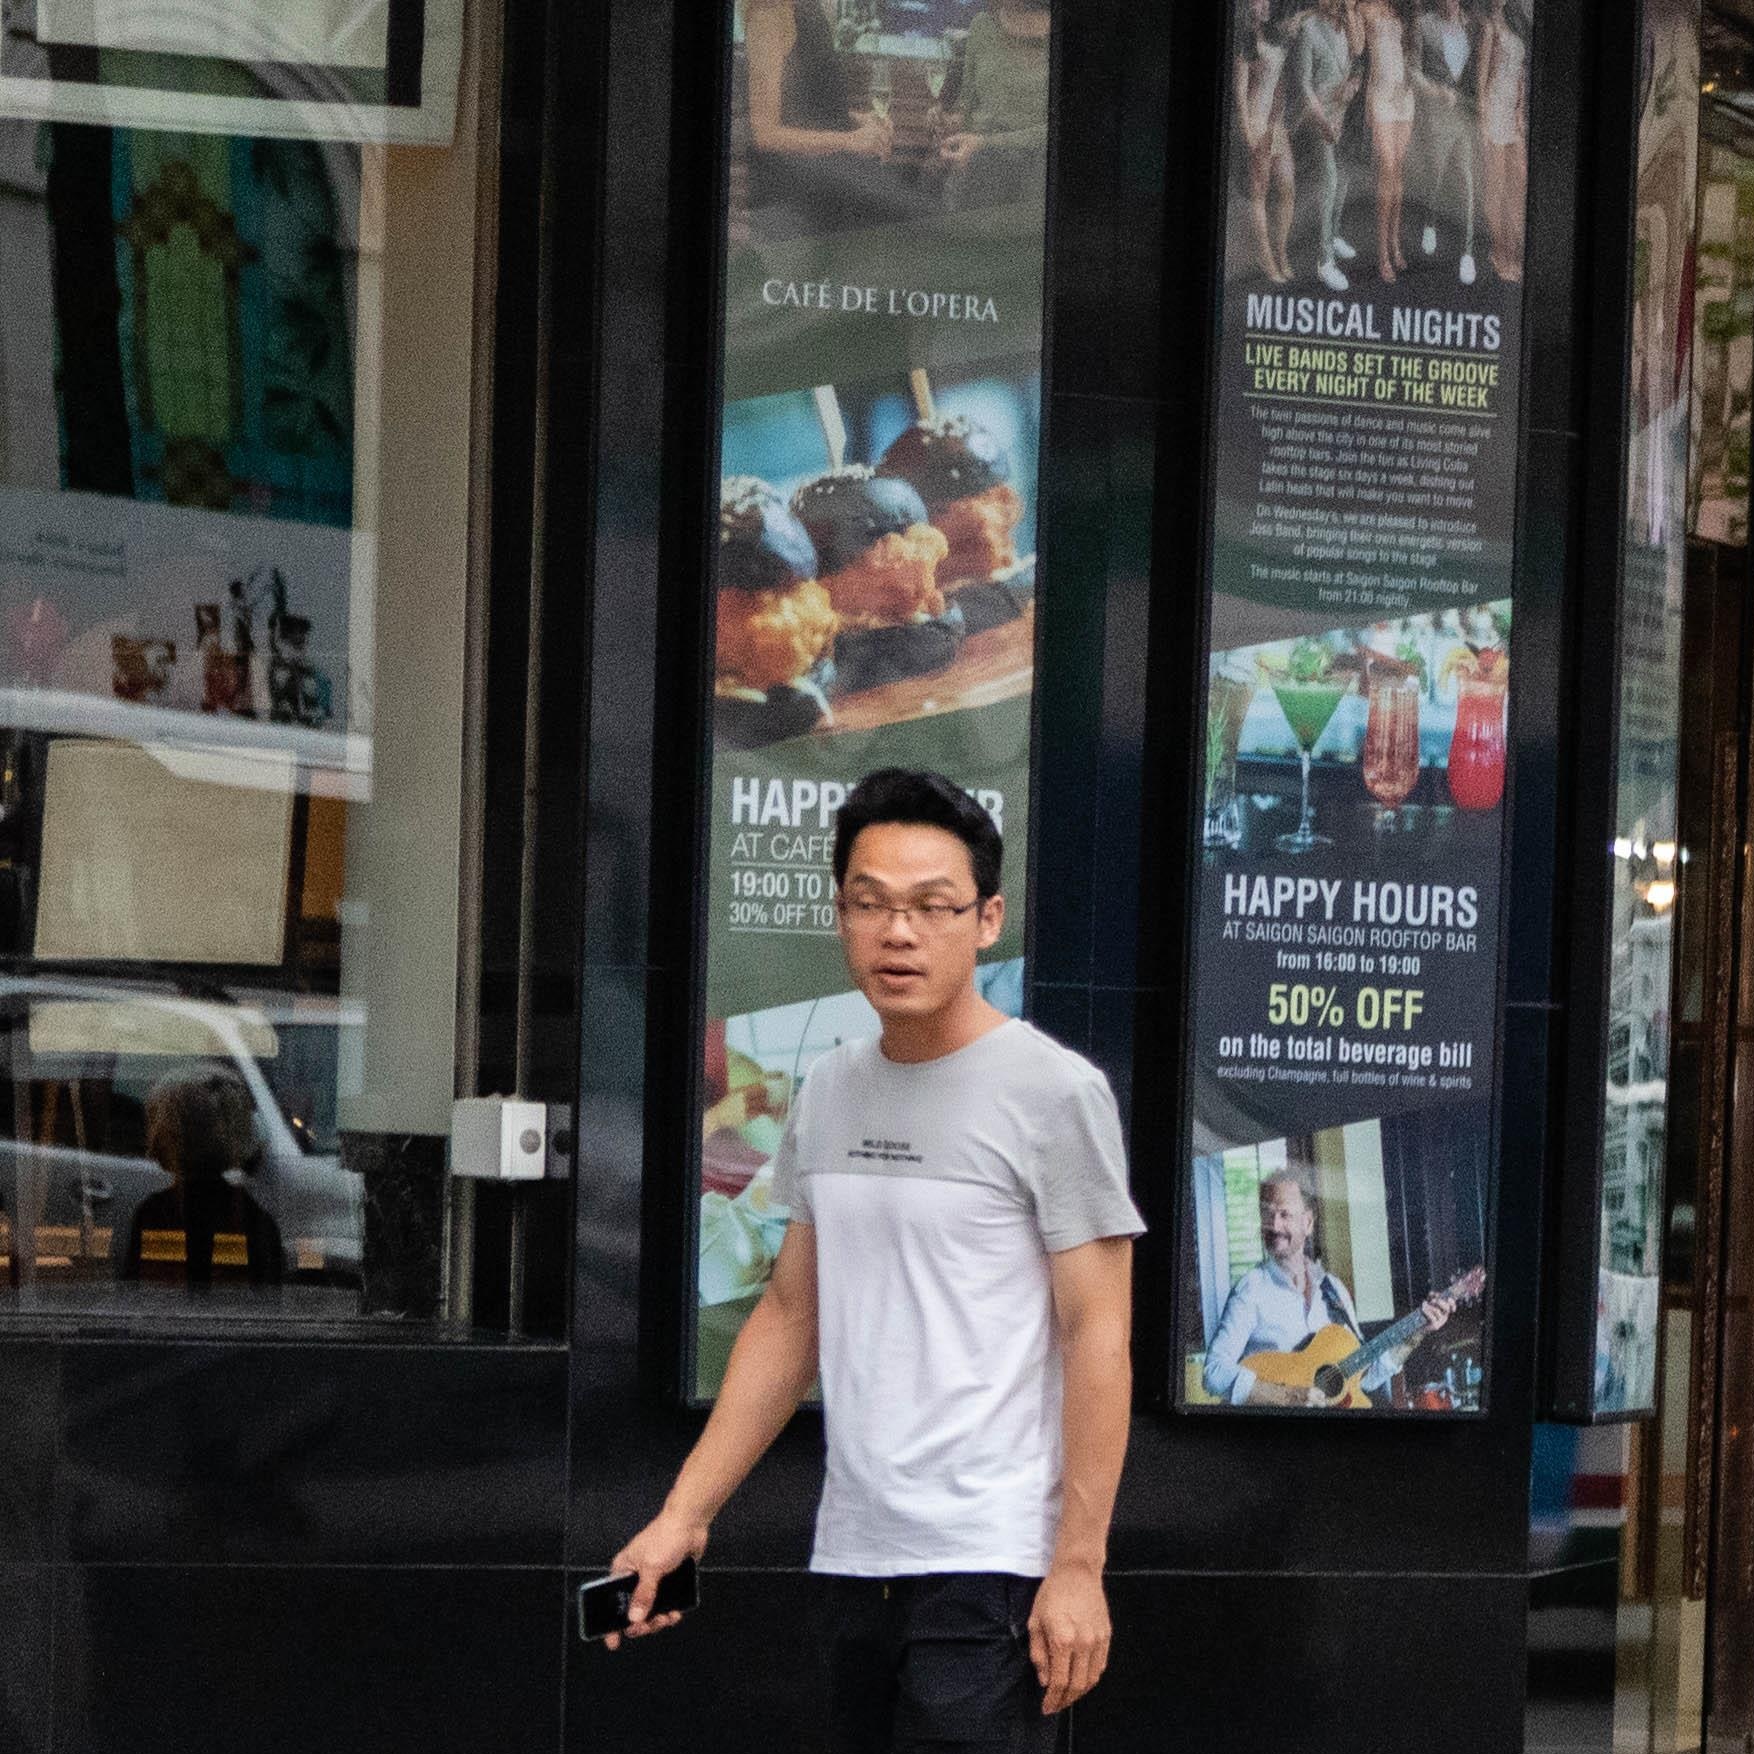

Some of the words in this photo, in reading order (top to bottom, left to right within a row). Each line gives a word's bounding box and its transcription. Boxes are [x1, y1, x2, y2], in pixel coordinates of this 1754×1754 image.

[762, 276, 832, 309] CAFÉ
[842, 285, 878, 313] DE
[887, 288, 999, 323] L'OPERA
[1246, 293, 1382, 340] MUSICAL
[1391, 305, 1501, 351] NIGHTS
[1245, 342, 1284, 366] LIVE
[1288, 346, 1348, 373] BANDS
[1353, 351, 1386, 376] SET
[1390, 355, 1424, 380] THE
[1427, 358, 1500, 387] GROOVE
[1254, 367, 1311, 393] EVERY
[1315, 372, 1370, 398] NIGHT
[1374, 377, 1398, 400] OF
[1402, 380, 1435, 404] THE
[1440, 384, 1489, 408] WEEK
[1354, 414, 1383, 430] dance
[1386, 417, 1404, 430] and
[1261, 425, 1284, 441] high
[1285, 427, 1316, 442] above
[1318, 429, 1333, 443] the
[1336, 431, 1353, 447] city
[1369, 435, 1386, 447] one
[1389, 434, 1399, 448] of
[1417, 438, 1442, 452] most
[1360, 450, 1375, 465] the
[1378, 451, 1394, 466] fun
[1262, 461, 1288, 476] takes
[1290, 462, 1307, 477] the
[1309, 465, 1336, 481] stage
[1355, 468, 1378, 485] days
[1259, 478, 1285, 494] Latin
[1315, 482, 1335, 497] that
[1358, 486, 1384, 502] make
[1386, 490, 1404, 504] you
[1407, 490, 1431, 505] want
[1433, 492, 1443, 506] to
[1343, 510, 1358, 524] we
[1360, 512, 1375, 525] are
[1378, 512, 1416, 530] pleased
[1418, 515, 1429, 530] to
[1306, 525, 1348, 545] bringing
[1306, 545, 1344, 562] popular
[1380, 548, 1390, 563] to
[1250, 563, 1268, 579] The
[1271, 565, 1301, 581] music
[1346, 571, 1381, 589] Saigon
[1383, 573, 1417, 591] Saigon
[1461, 578, 1478, 594] Bar
[1318, 587, 1342, 602] from
[731, 776, 856, 829] HAPP
[730, 832, 764, 859] AT
[730, 870, 789, 899] 19:00
[796, 872, 822, 900] TO
[729, 901, 768, 925] 30%
[773, 903, 807, 927] OFF
[1224, 873, 1342, 921] HAPPY
[1353, 880, 1479, 929] HOURS
[1222, 920, 1242, 941] AT
[1245, 921, 1303, 944] SAIGON
[1307, 924, 1366, 947] SAIGON
[1370, 928, 1442, 951] ROOFTOP
[1446, 932, 1477, 953] BAR
[1276, 950, 1310, 970] from
[1315, 951, 1357, 973] 16:00
[1360, 953, 1375, 973] to
[1379, 955, 1421, 976] 19:00
[1268, 983, 1345, 1028] 50%
[1356, 986, 1425, 1031] OFF
[1219, 1035, 1243, 1058] on
[1250, 1033, 1281, 1060] the
[1287, 1034, 1332, 1062] total
[1338, 1037, 1433, 1070] beverage
[1439, 1041, 1472, 1068] bill
[1216, 1065, 1266, 1084] excluding
[1332, 1068, 1350, 1084] full
[1352, 1070, 1386, 1087] bottles
[1388, 1071, 1400, 1087] of
[1401, 1073, 1426, 1088] wine
[1428, 1074, 1437, 1088] &
[1439, 1074, 1473, 1090] spirits
